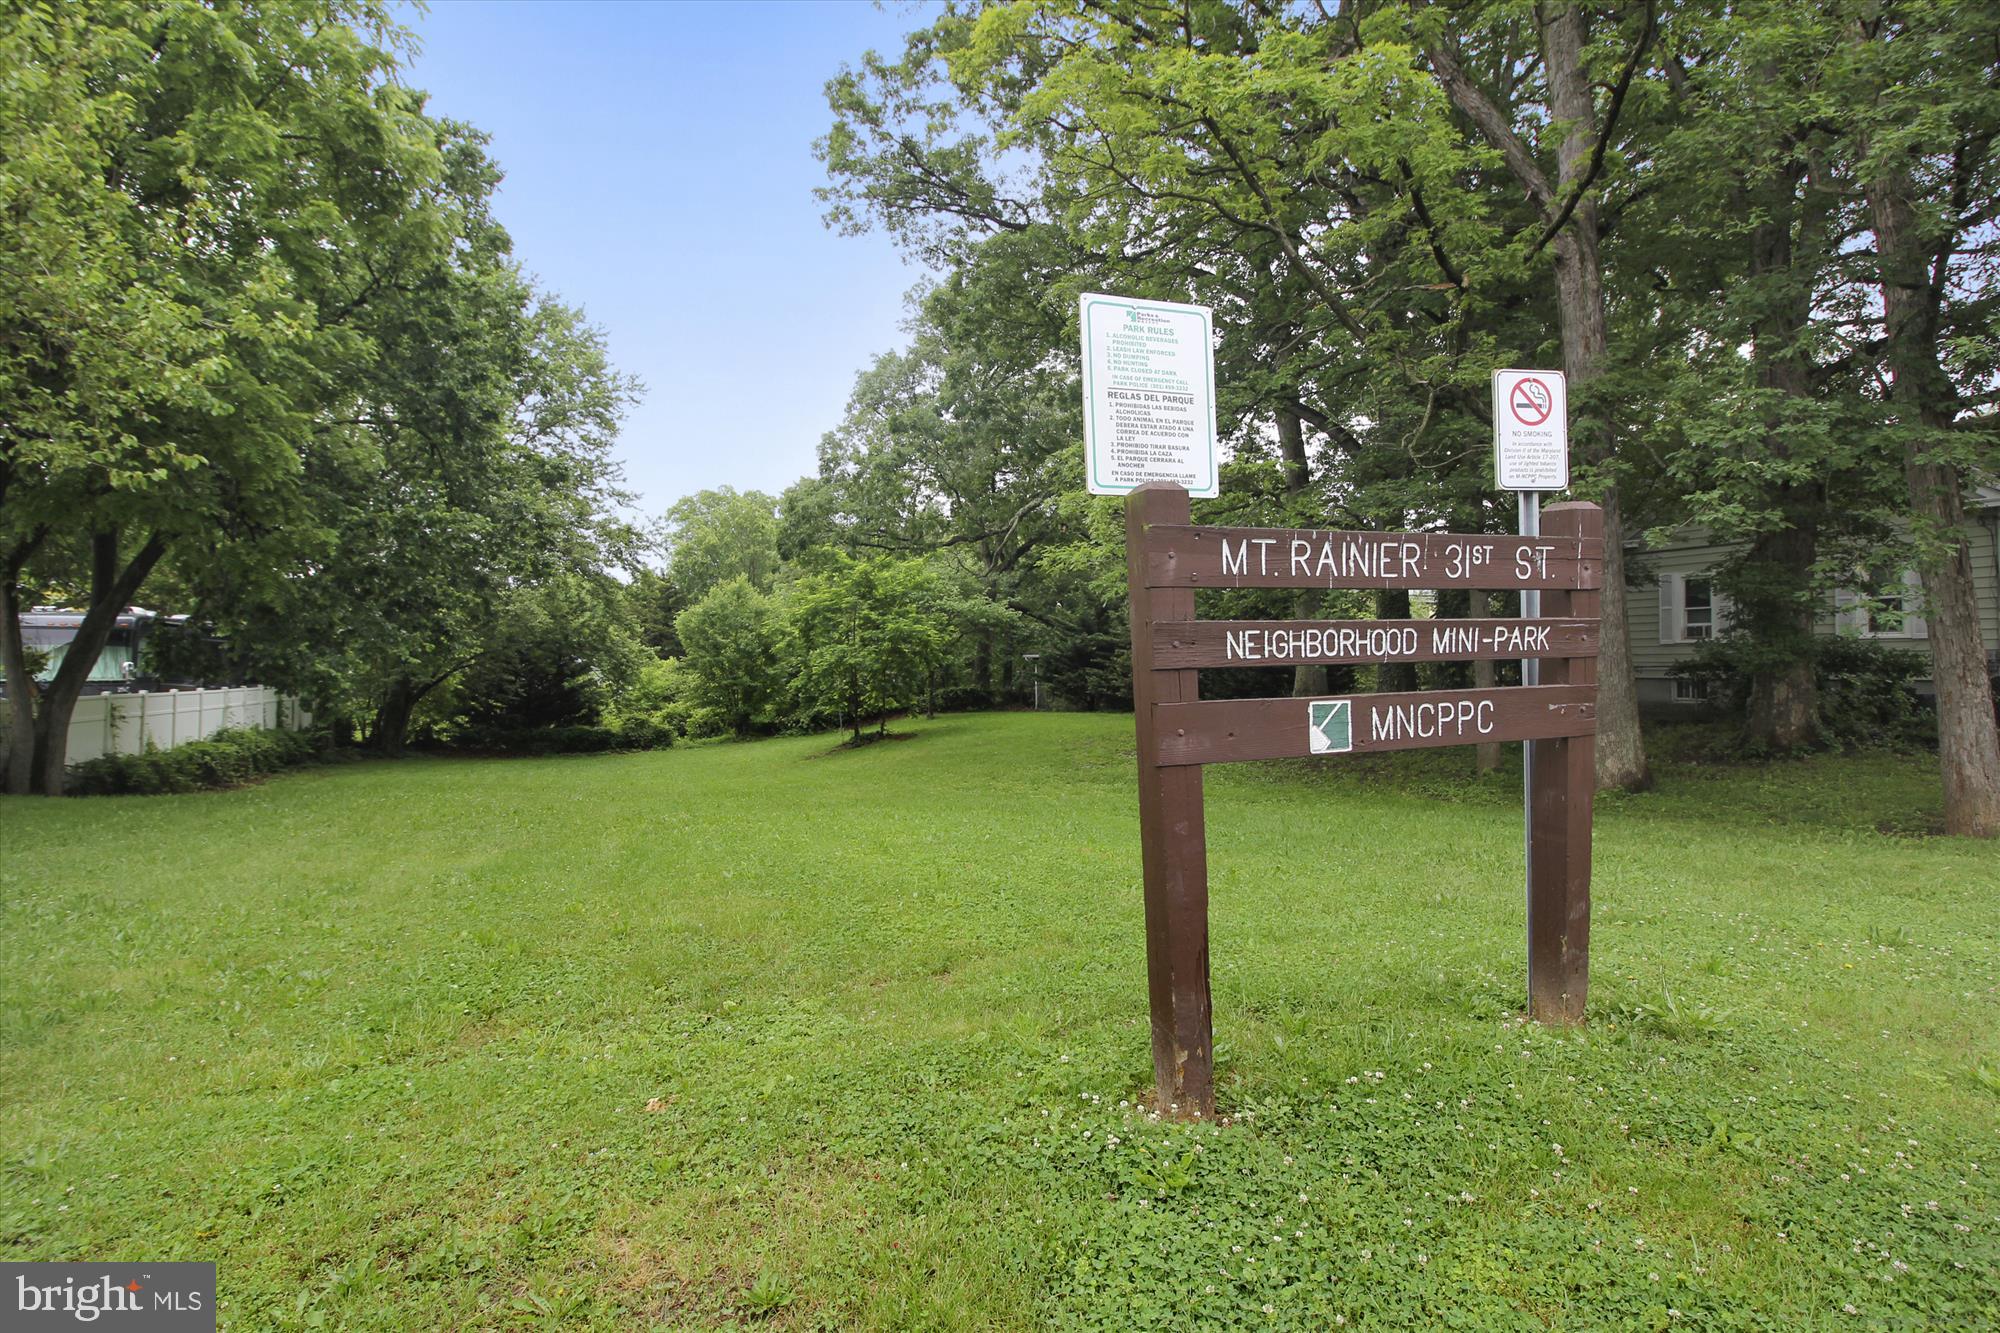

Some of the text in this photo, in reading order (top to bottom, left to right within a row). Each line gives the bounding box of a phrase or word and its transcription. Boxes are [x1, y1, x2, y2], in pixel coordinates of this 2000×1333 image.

[1123, 324, 1174, 336] PARK RULES
[1107, 392, 1141, 400] REGLAS
[1162, 395, 1194, 404] PARQUE
[1221, 539, 1556, 580] MT. RAINIER 31ST ST.
[1226, 626, 1552, 659] NEIGHBORHOOD MINI-PARK
[1372, 700, 1494, 741] MNCPPC
